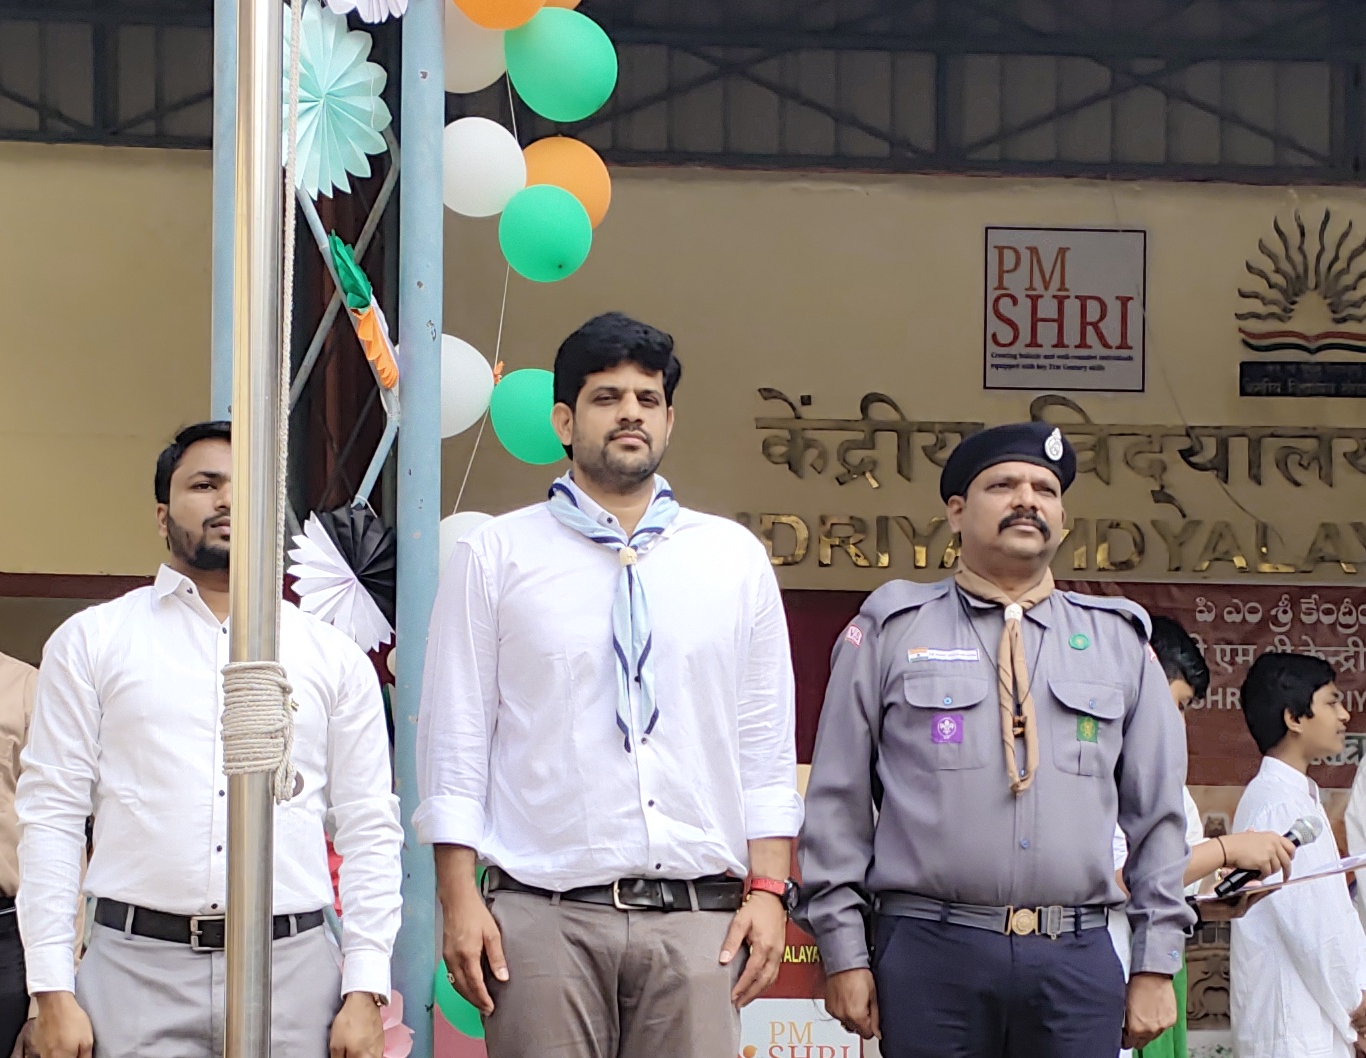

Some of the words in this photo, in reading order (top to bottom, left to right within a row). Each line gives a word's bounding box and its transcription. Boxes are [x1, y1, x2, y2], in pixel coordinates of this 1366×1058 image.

[993, 245, 1071, 292] PM
[991, 292, 1134, 350] SHRI
[769, 1021, 814, 1045] PM
